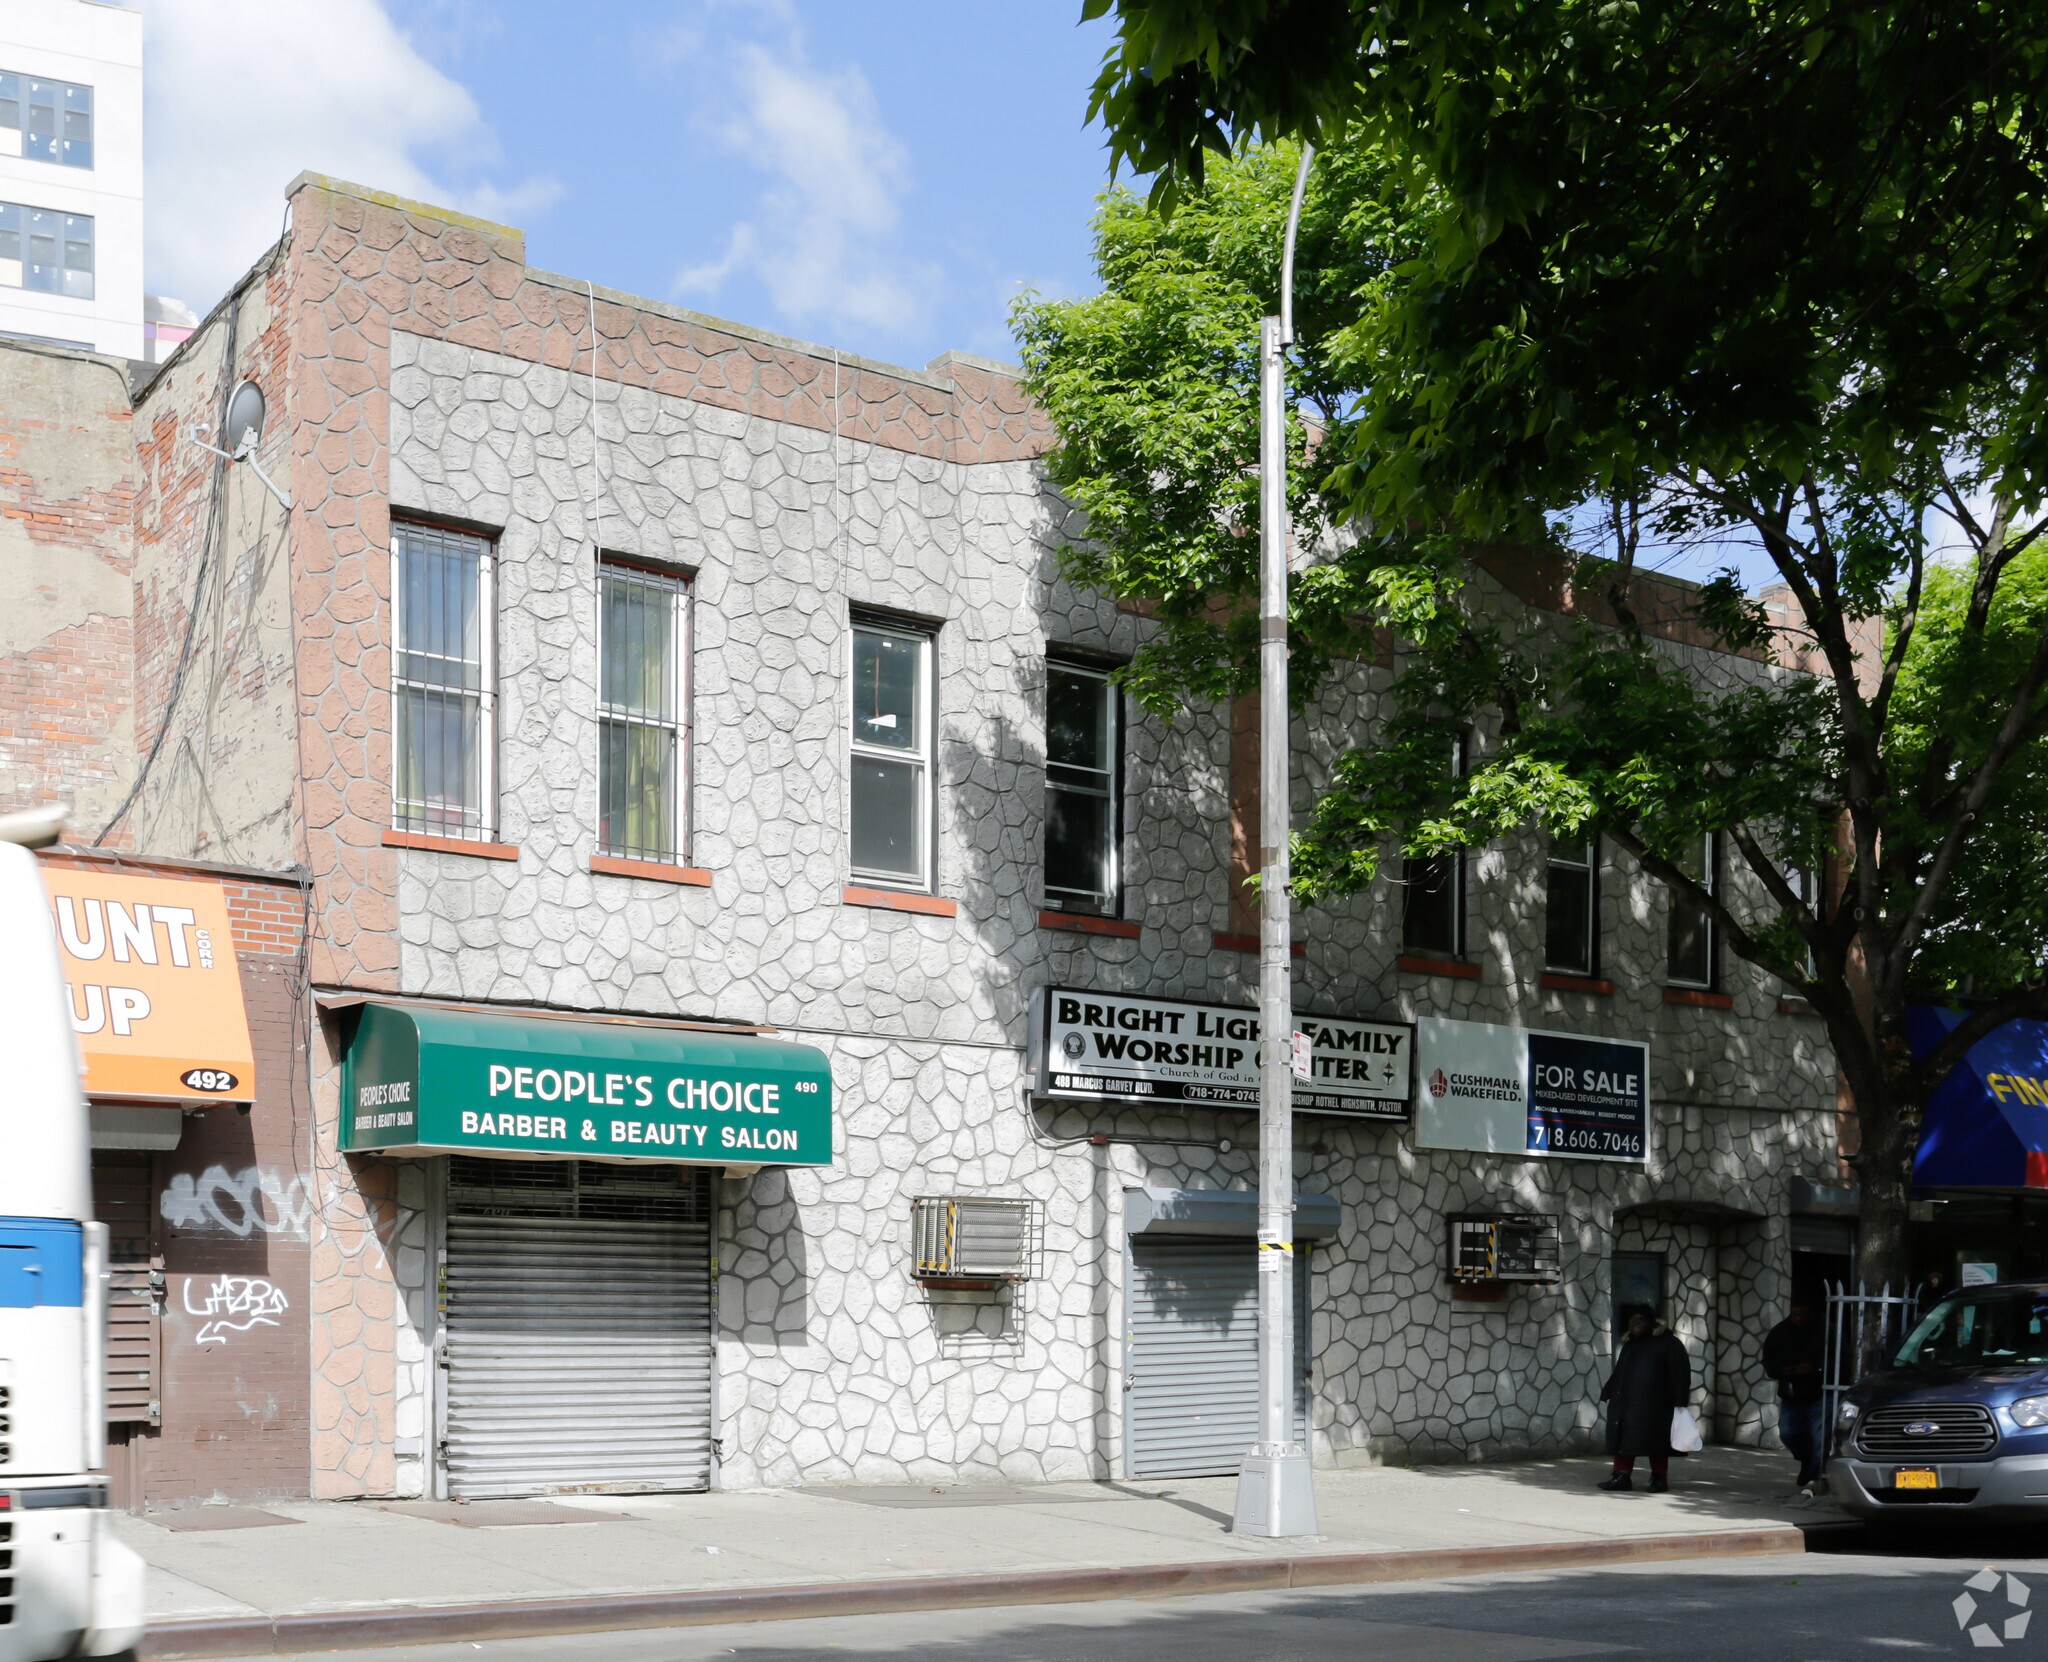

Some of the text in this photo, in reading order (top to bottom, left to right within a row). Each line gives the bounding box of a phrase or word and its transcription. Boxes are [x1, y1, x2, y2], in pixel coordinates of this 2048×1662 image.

[50, 895, 196, 968] UNT
[1058, 997, 1186, 1034] BRIGHT
[1196, 1011, 1260, 1042] LIGH
[1301, 1022, 1404, 1055] FAMILY
[1092, 1032, 1244, 1069] WORSHIP
[187, 1070, 231, 1090] 492
[1160, 1066, 1199, 1078] Church
[1203, 1071, 1214, 1079] of
[1218, 1072, 1239, 1082] God
[1244, 1074, 1254, 1082] in
[1294, 1079, 1313, 1088] Inc.
[1450, 1073, 1520, 1090] CUSHMAN &
[1535, 1064, 1638, 1096] FOR SALE
[360, 1081, 411, 1107] PEOPLE'S CHOICE
[794, 1081, 818, 1093] 490
[1072, 1076, 1104, 1090] MARCUS
[1105, 1079, 1134, 1093] GARVEY
[1135, 1081, 1155, 1094] BLVD.
[1450, 1085, 1522, 1102] WAKEFIELD.
[1986, 1072, 2048, 1108] FIN
[667, 1078, 780, 1114] CHOICE
[1535, 1089, 1638, 1108] MIXED-USED DEVELOPMENT SITE
[1378, 1102, 1402, 1113] PASTOR
[1535, 1105, 1558, 1113] MICHAEL
[355, 1115, 373, 1130] BARBER
[378, 1112, 396, 1128] BEAUTY
[397, 1111, 413, 1126] SALON
[462, 1111, 798, 1151] BARBER & BEAUTY SALON
[1534, 1126, 1640, 1152] 718.606.7046
